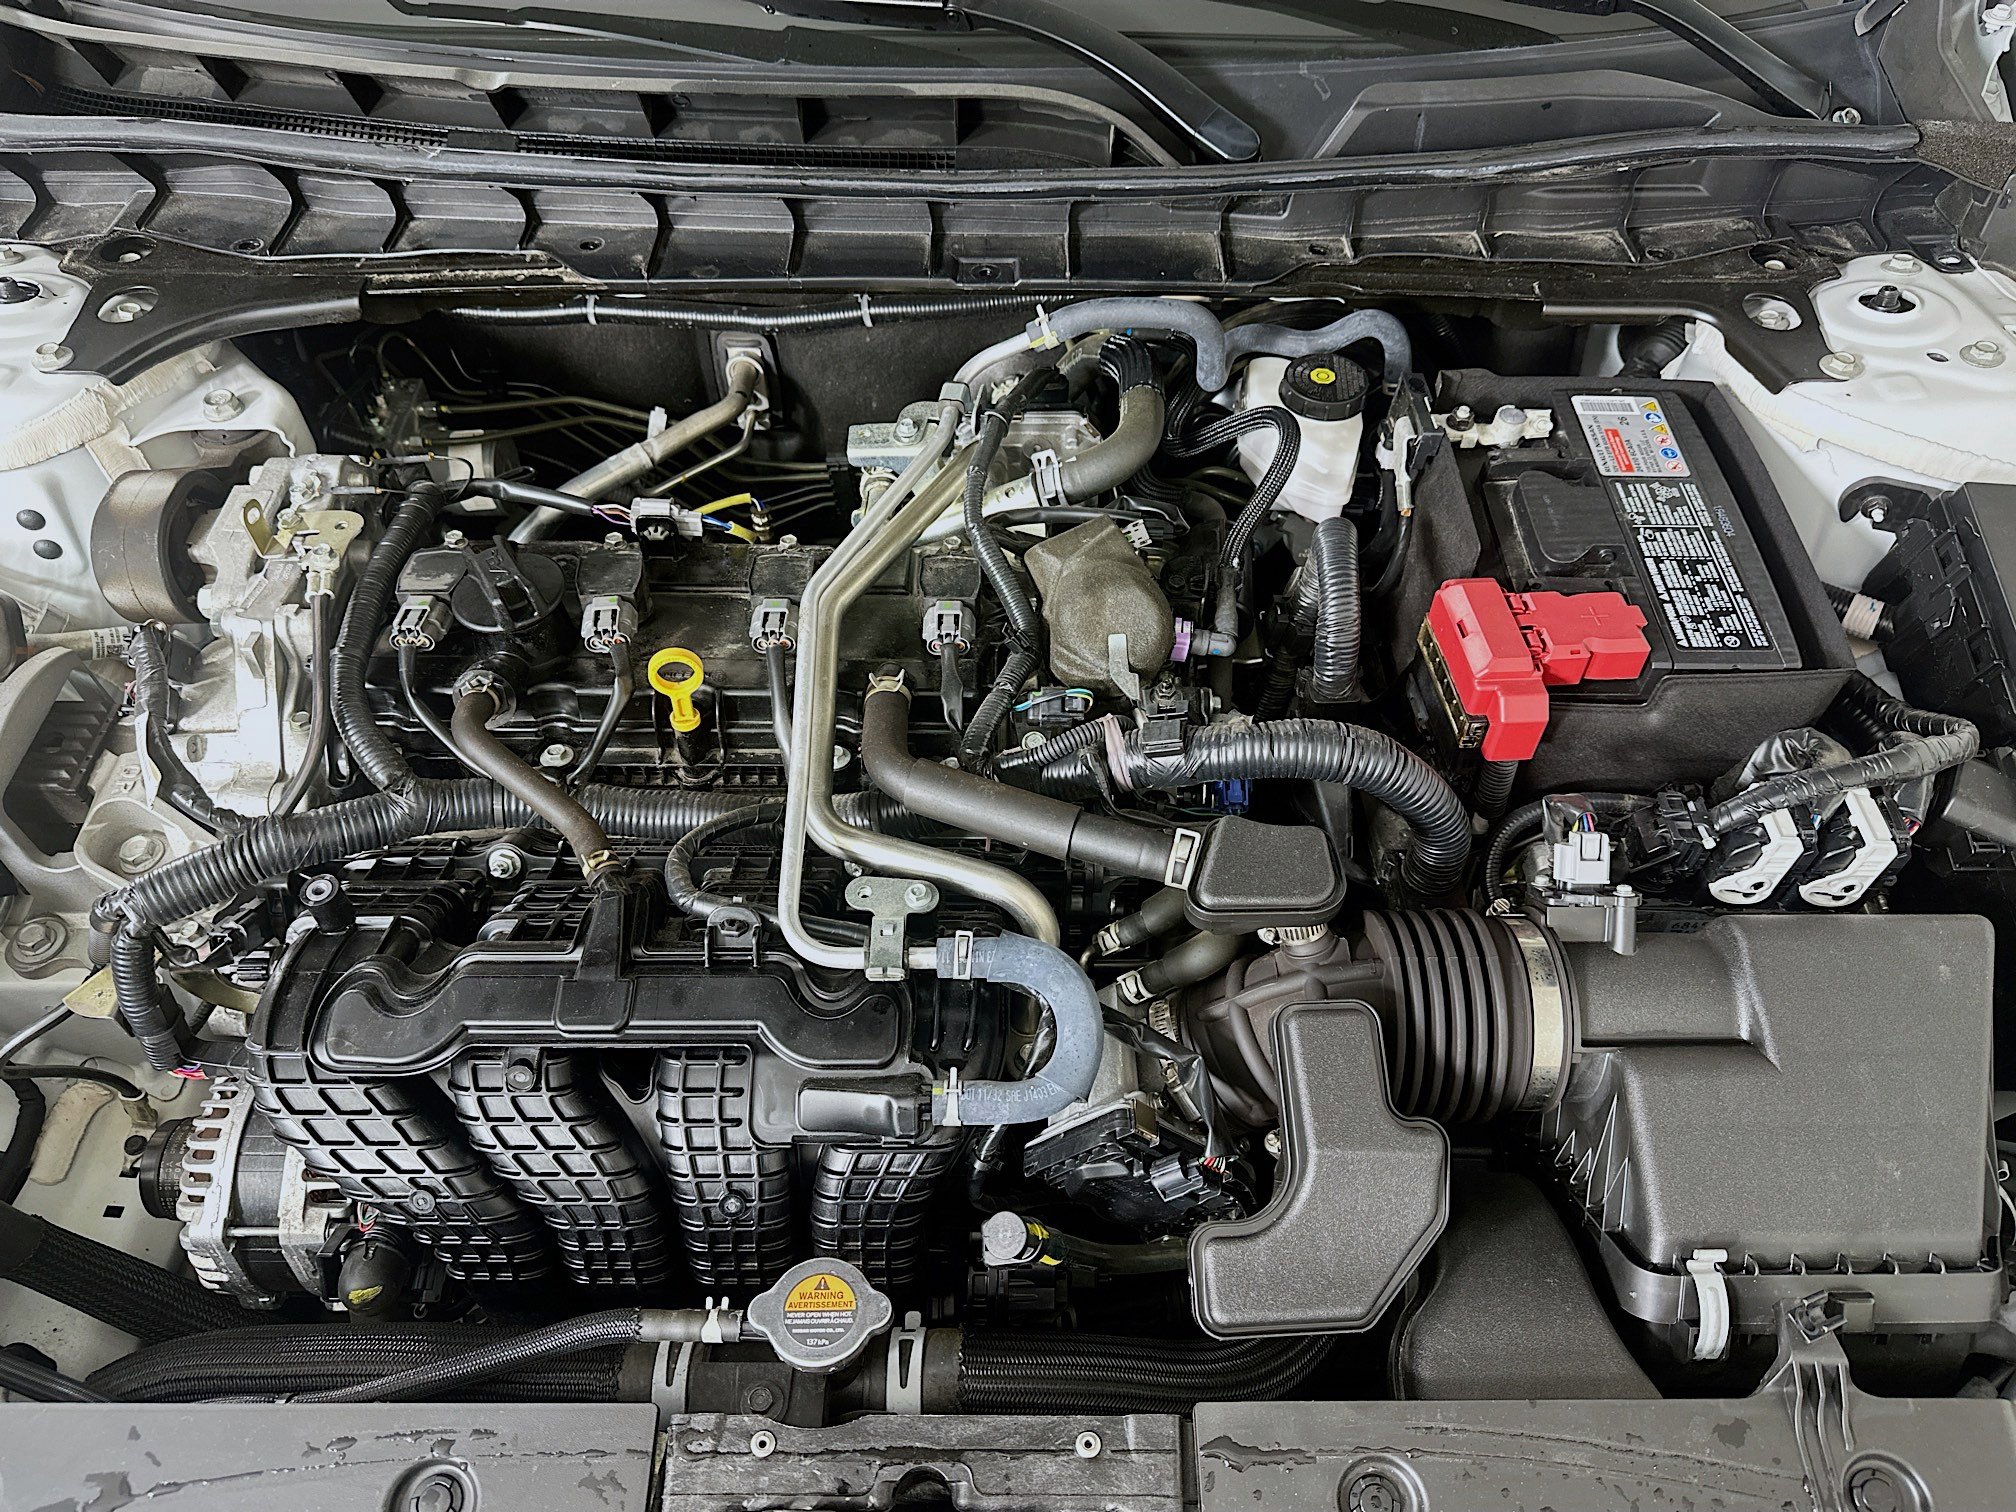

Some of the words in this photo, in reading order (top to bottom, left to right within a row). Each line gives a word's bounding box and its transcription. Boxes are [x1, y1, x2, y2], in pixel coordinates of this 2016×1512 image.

[1618, 416, 1629, 425] 26
[1006, 1089, 1022, 1102] SAE
[799, 1291, 844, 1300] WARNING
[788, 1300, 854, 1309] AVERTISSEMENT
